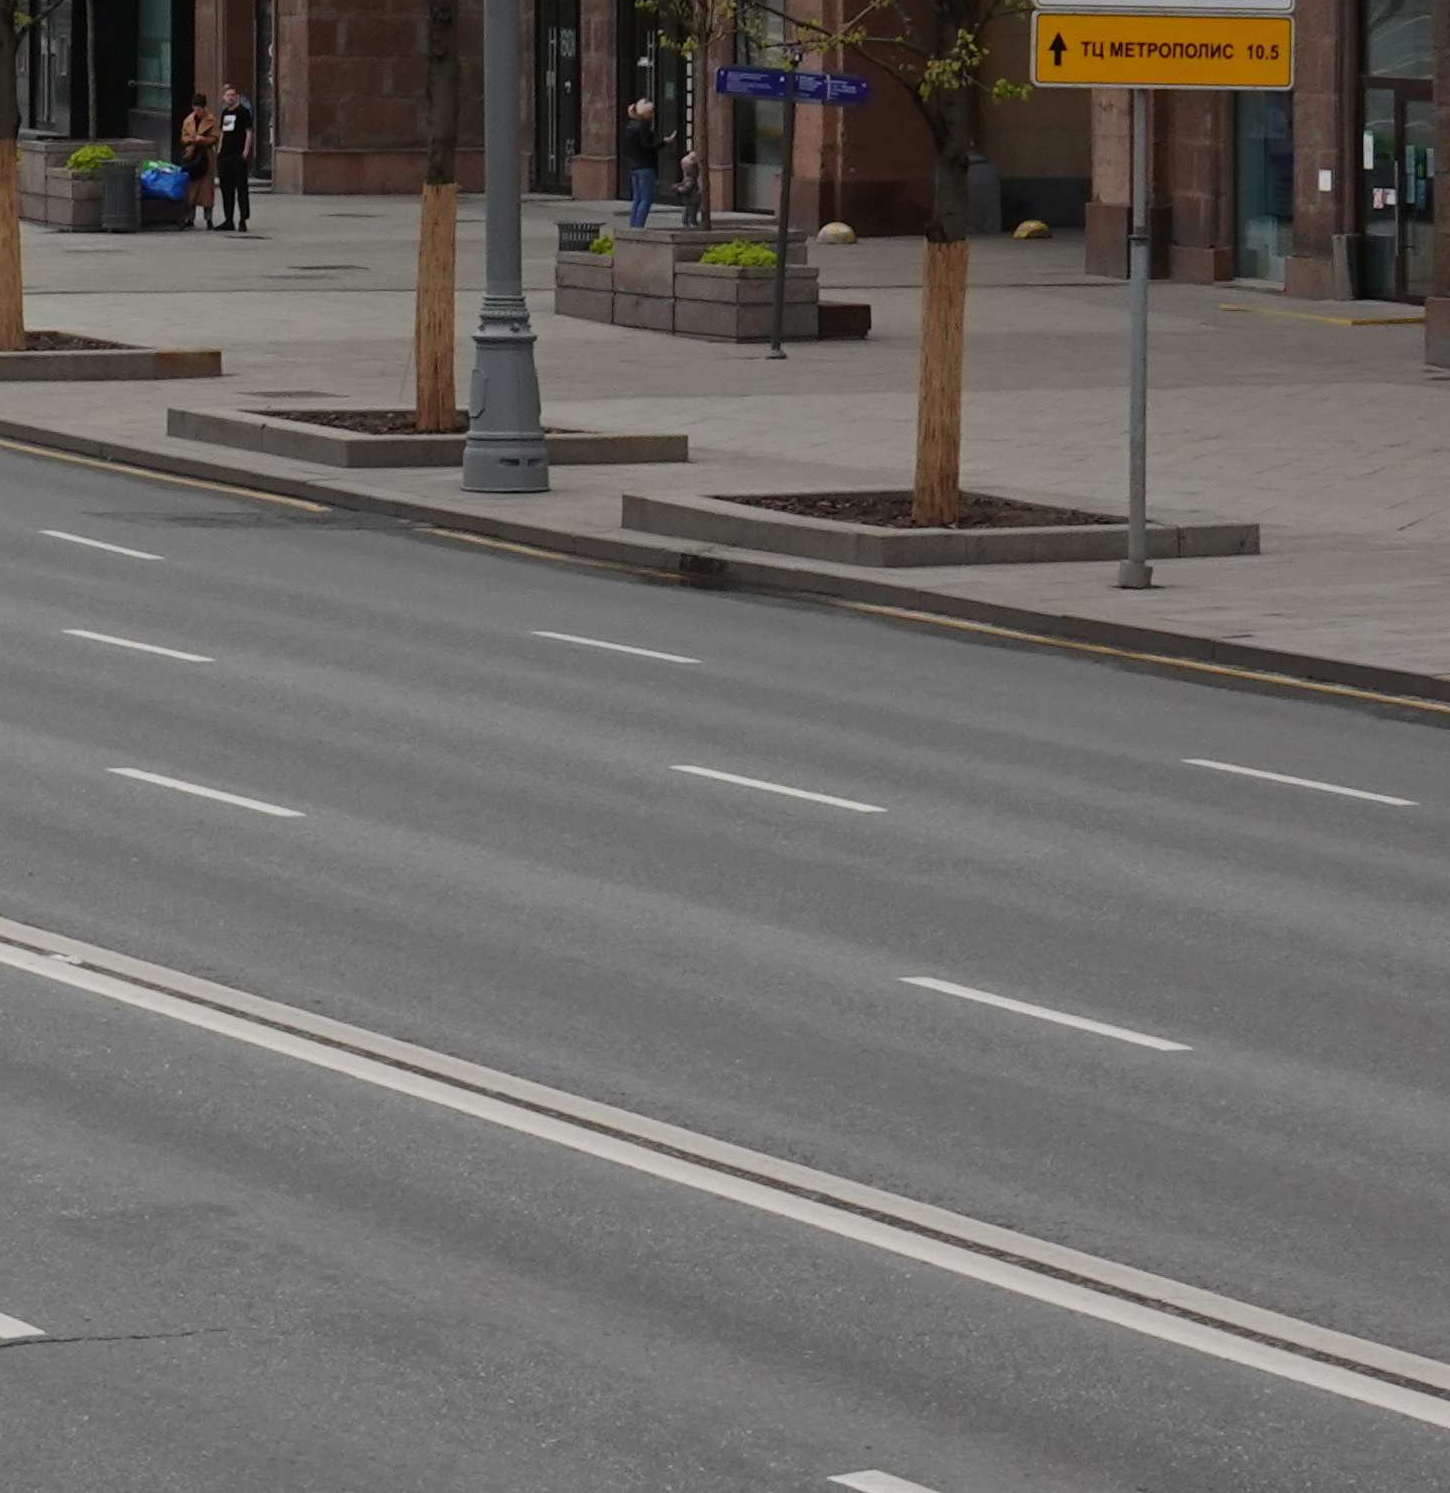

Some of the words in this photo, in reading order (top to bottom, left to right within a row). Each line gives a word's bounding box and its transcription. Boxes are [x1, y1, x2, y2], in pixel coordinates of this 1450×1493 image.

[1081, 41, 1105, 60] ТЦ
[1110, 42, 1234, 60] МЕТРОПОЛИС
[1247, 44, 1280, 60] 10.5
